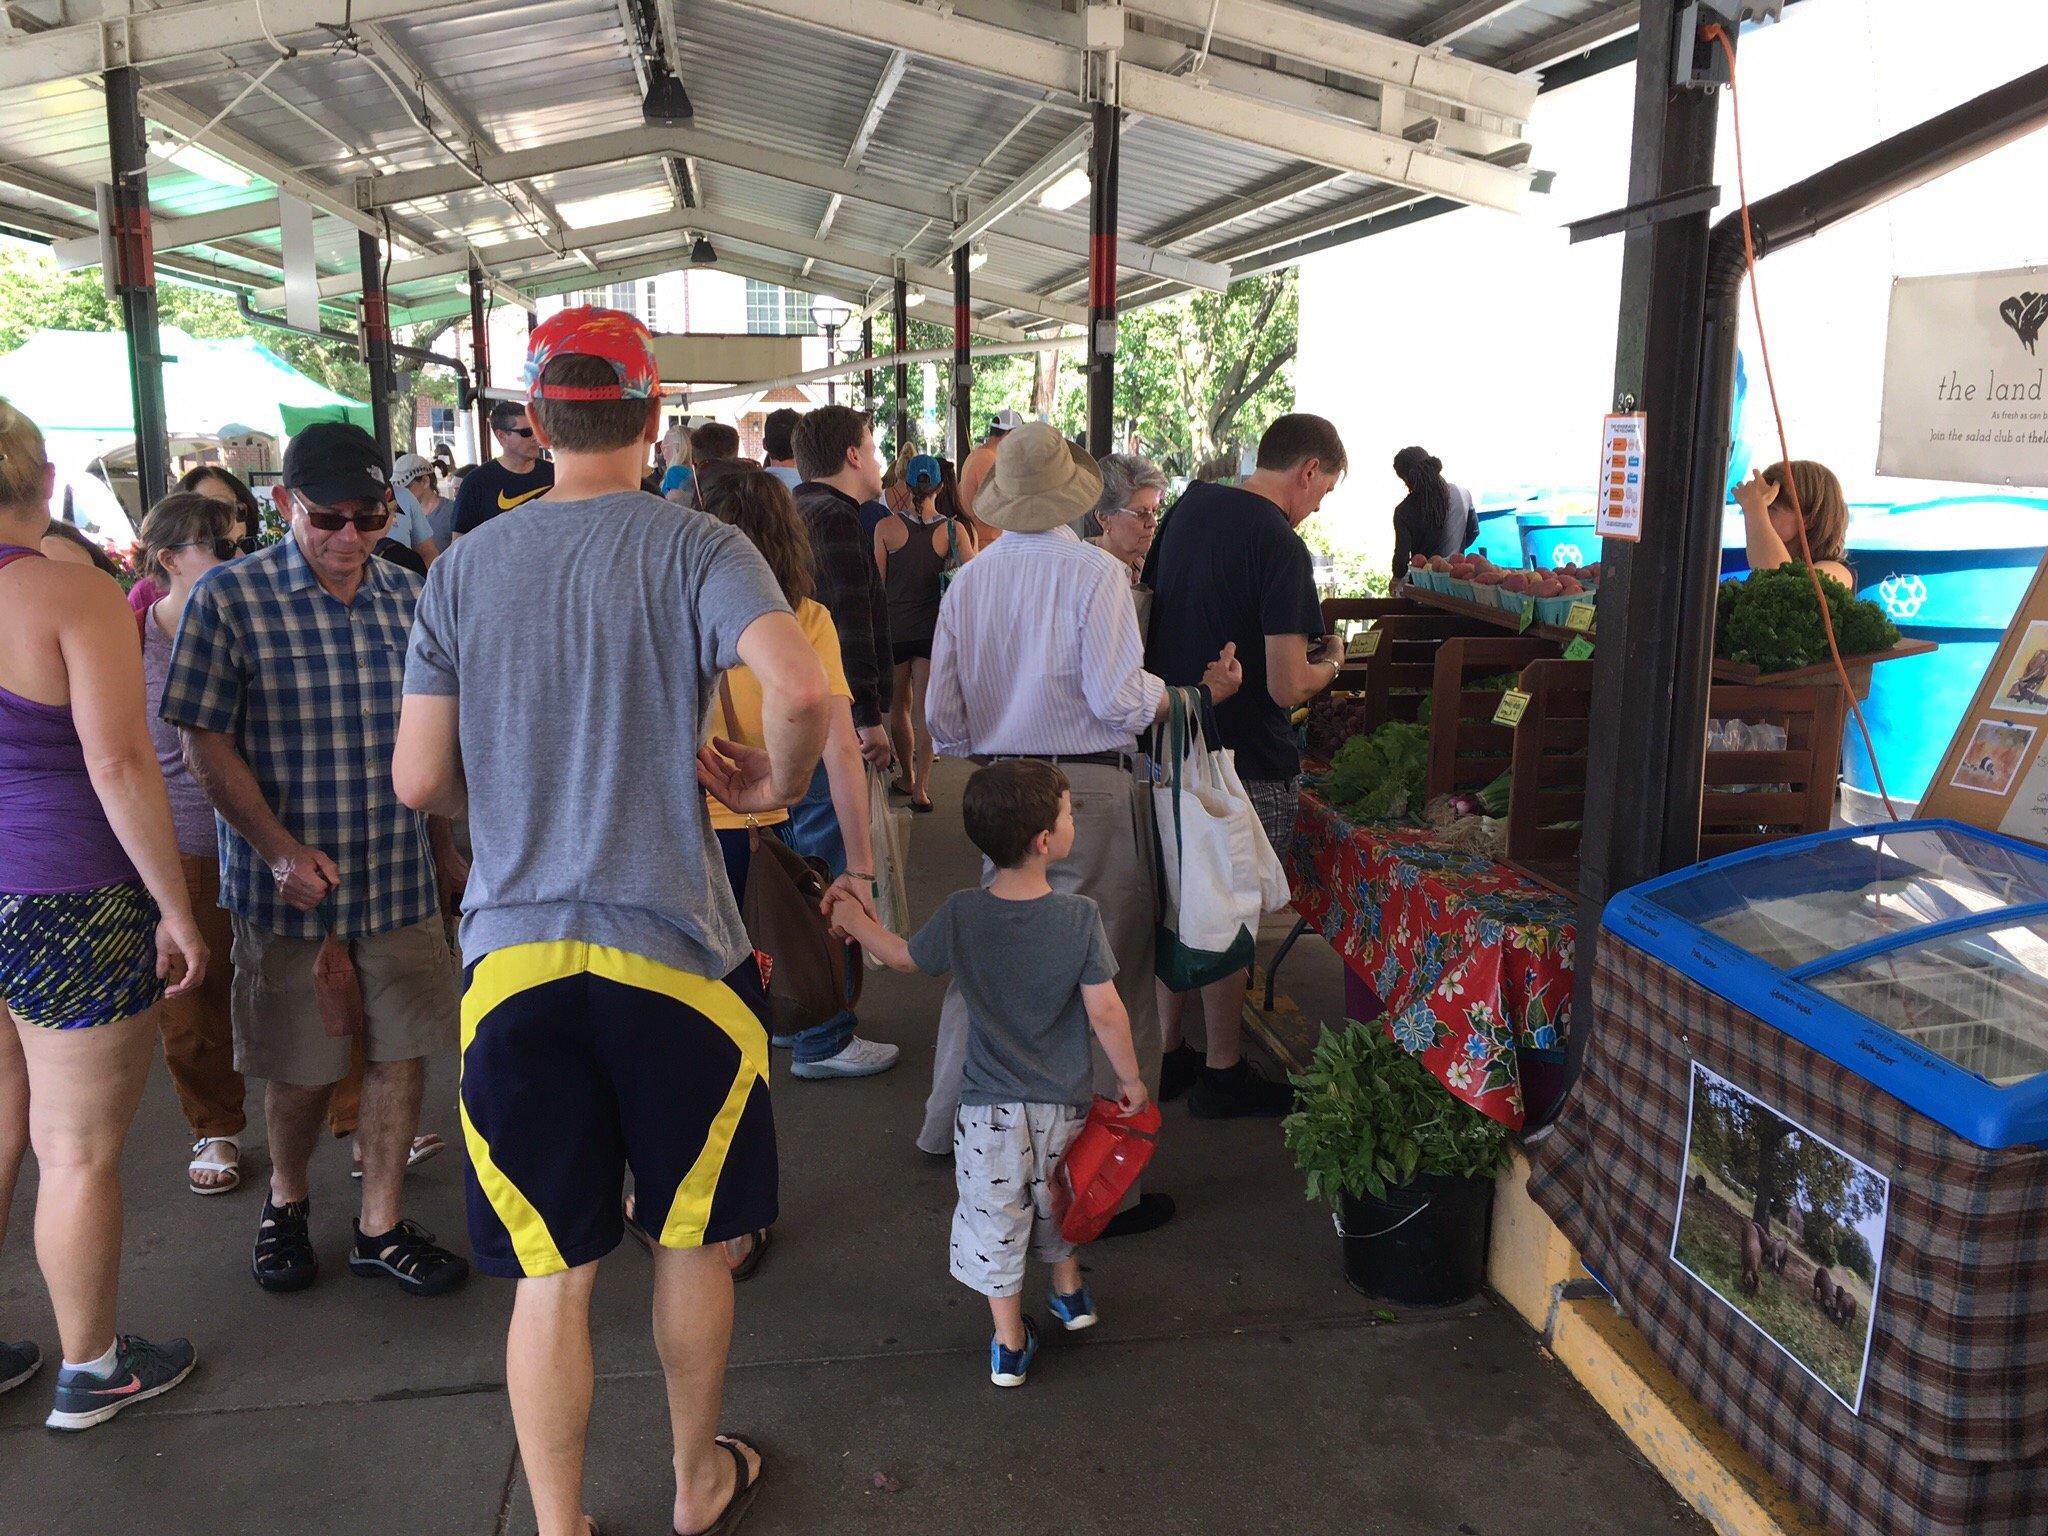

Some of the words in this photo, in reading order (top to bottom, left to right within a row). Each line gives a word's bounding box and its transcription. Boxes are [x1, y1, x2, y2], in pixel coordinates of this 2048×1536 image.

[1938, 370, 1977, 401] the
[1986, 368, 2043, 401] land
[1991, 411, 2000, 420] As
[2001, 410, 2019, 420] fresh
[1929, 428, 1945, 442] Join
[1948, 428, 1963, 441] the
[1966, 429, 1992, 442] salad
[1994, 430, 2013, 443] club
[2015, 432, 2026, 443] at
